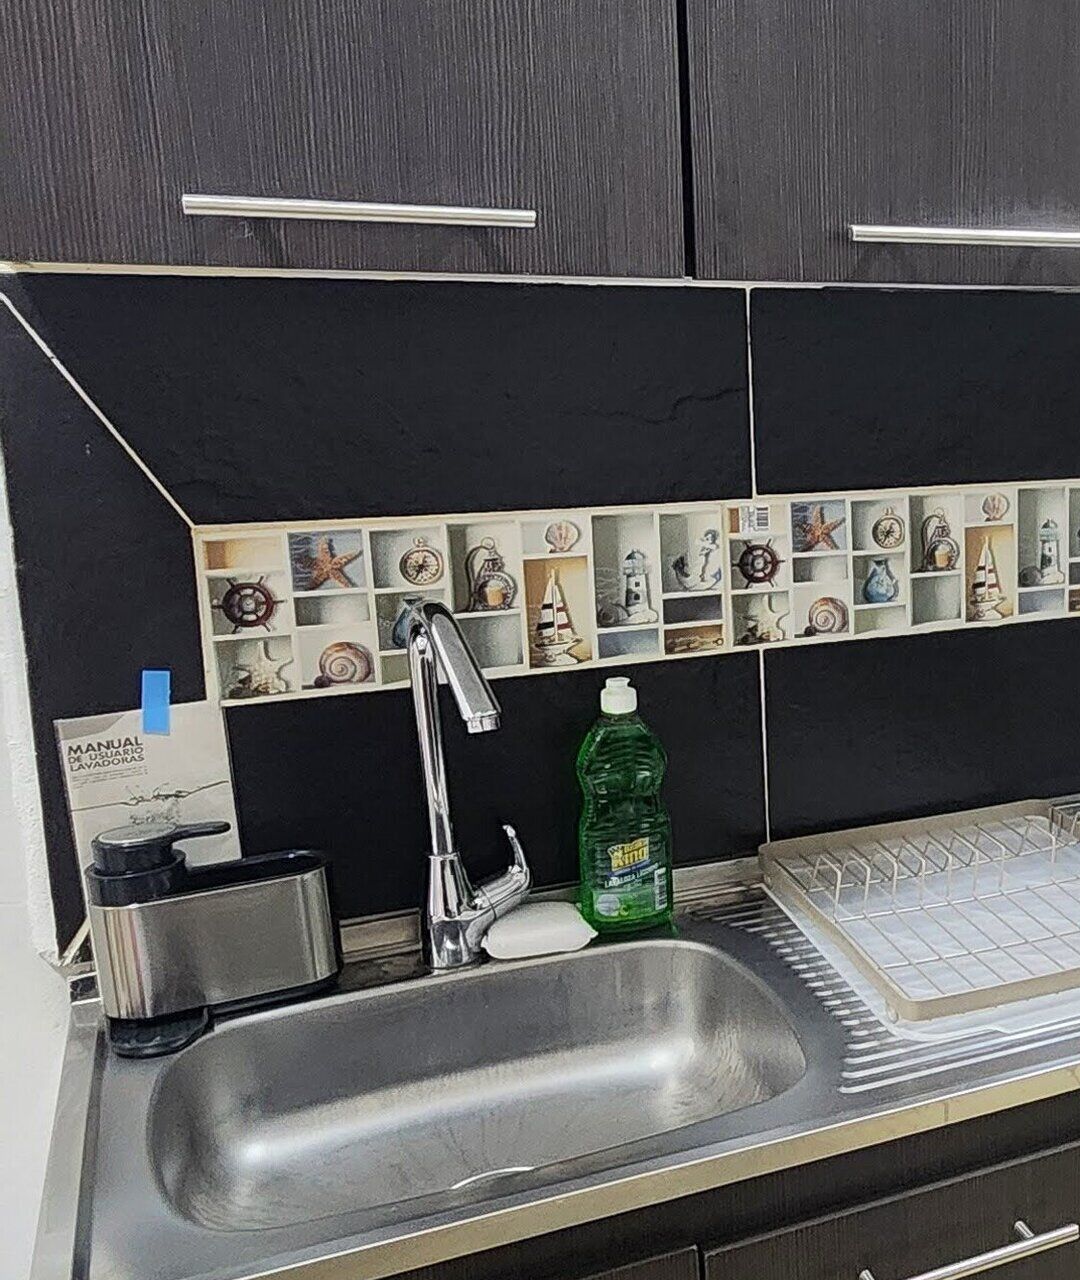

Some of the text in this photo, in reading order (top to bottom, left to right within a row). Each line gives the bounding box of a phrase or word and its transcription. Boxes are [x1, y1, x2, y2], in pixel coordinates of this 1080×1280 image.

[67, 736, 143, 756] MANUAL
[68, 746, 144, 765] DE USUARIO
[70, 753, 145, 772] LAVADORAS
